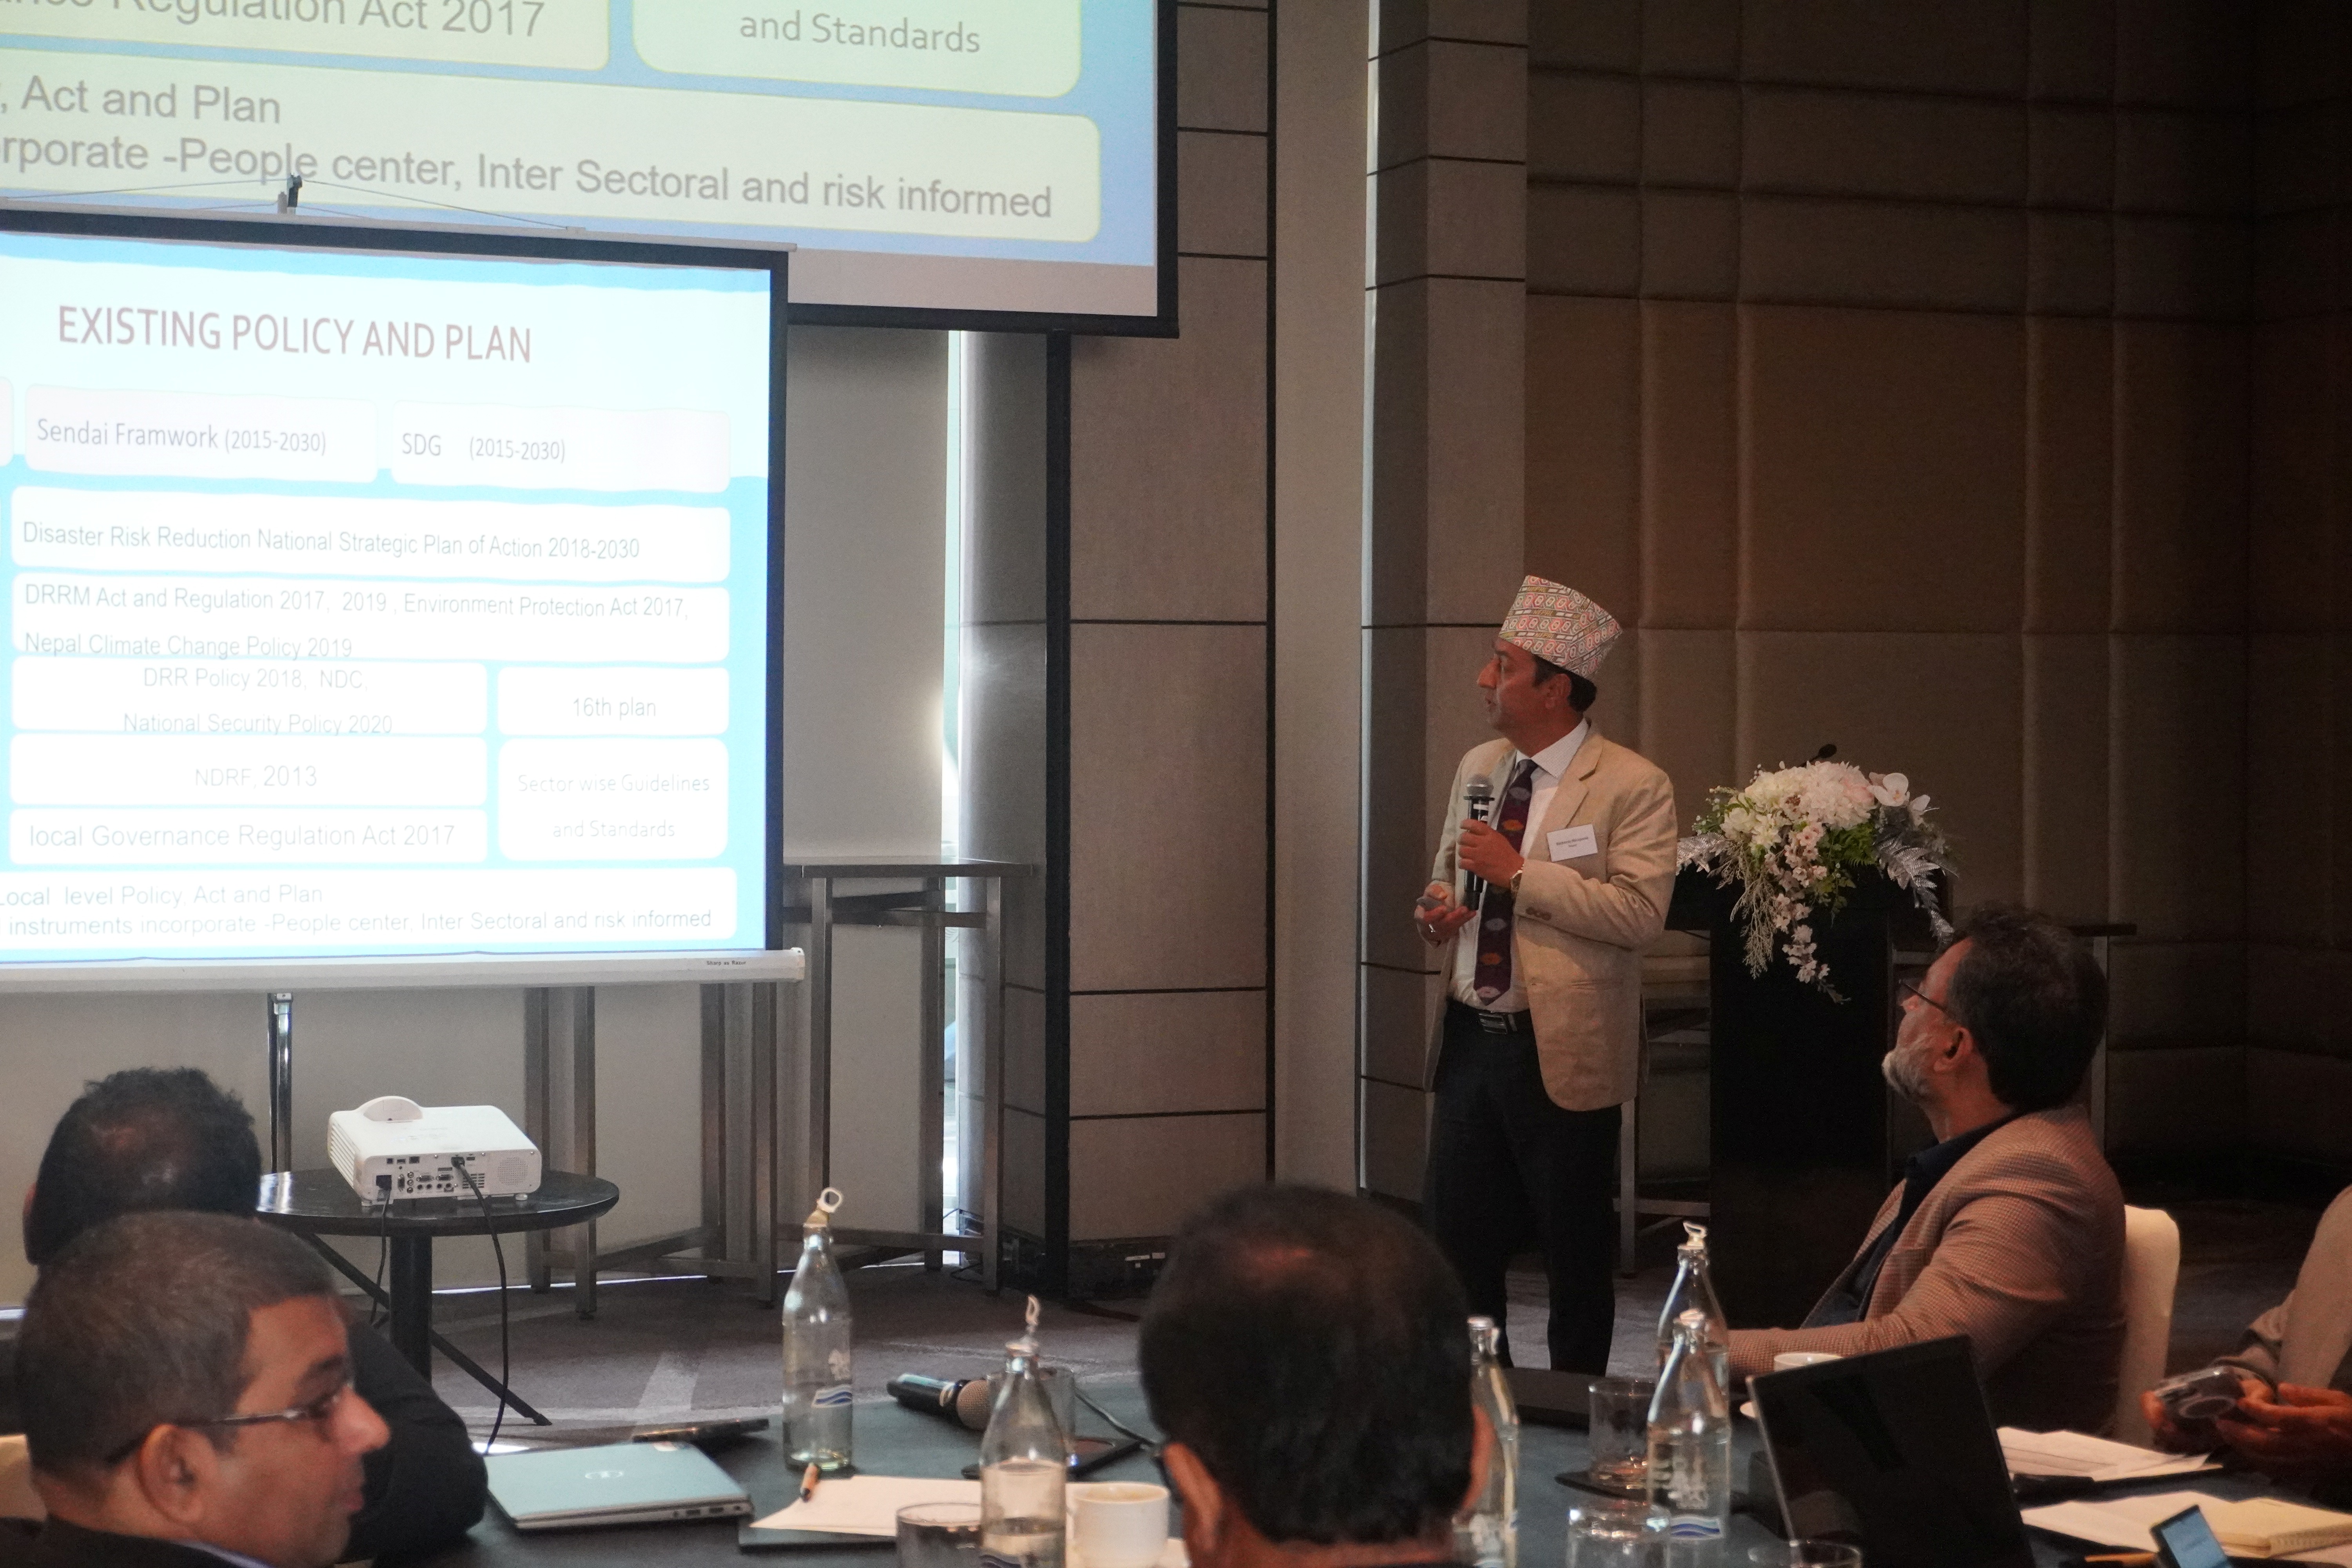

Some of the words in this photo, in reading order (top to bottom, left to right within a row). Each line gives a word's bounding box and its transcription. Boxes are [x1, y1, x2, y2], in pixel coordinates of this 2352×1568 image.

[358, 0, 428, 29] Act
[442, 0, 544, 36] 2017
[740, 9, 800, 41] and
[812, 13, 980, 53] Standards
[21, 75, 89, 113] Act
[102, 83, 176, 118] and
[194, 84, 280, 124] Plan
[479, 153, 563, 191] Inter
[576, 159, 728, 200] Sectoral
[742, 171, 808, 205] and
[824, 173, 885, 209] risk
[899, 177, 1051, 218] informed
[60, 305, 220, 349] EXISTING
[233, 314, 354, 354] POLICY
[363, 321, 434, 358] AND
[446, 324, 530, 363] PLAN
[37, 418, 107, 445] Sendai
[116, 423, 218, 448] Framwork
[225, 429, 326, 456] (2015-2030)
[402, 433, 441, 456] SDG
[470, 437, 565, 463] (2015-2030)
[23, 521, 104, 546] Disaster
[111, 526, 150, 546] Risk
[157, 526, 250, 549] Reduction
[258, 528, 332, 550] National
[339, 531, 417, 558] Strategic
[424, 534, 462, 554] Plan
[469, 534, 485, 554] of
[489, 535, 542, 557] Action
[548, 537, 639, 559] 2018-2030
[25, 583, 90, 605] DRRM
[96, 587, 126, 607] Act
[133, 588, 167, 607] and
[174, 587, 273, 613] Regulation
[404, 593, 513, 615] Environment
[520, 596, 604, 617] Protection
[610, 597, 637, 615] Act
[25, 632, 81, 658] Nepal
[89, 634, 160, 655] Climate
[167, 635, 239, 661] Change
[247, 635, 301, 661] Policy
[308, 637, 352, 658] 2019
[144, 667, 187, 686] DRR
[195, 668, 250, 691] Policy
[573, 697, 611, 717] 16th
[619, 697, 656, 720] plan
[123, 713, 200, 735] National
[207, 714, 281, 736] Security
[289, 714, 342, 737] Policy
[348, 715, 393, 737] 2020
[263, 765, 317, 787] 2013
[518, 774, 574, 792] Sector
[580, 775, 616, 791] wise
[622, 774, 710, 792] Guidelines
[30, 825, 82, 846] local
[92, 825, 229, 846] Governance
[239, 824, 355, 851] Regulation
[362, 825, 395, 845] Act
[404, 825, 455, 846] 2017
[553, 821, 584, 838] and
[590, 820, 675, 837] Standards
[0, 887, 50, 906] ocal
[65, 886, 113, 905] level
[193, 886, 225, 904] Act
[234, 886, 270, 903] and
[279, 884, 322, 902] Plan
[9, 917, 132, 935] instruments
[141, 916, 256, 936] incorporate
[422, 913, 463, 930] Inter
[471, 912, 546, 930] Sectoral
[554, 912, 587, 929] and
[595, 912, 625, 928] risk
[633, 910, 711, 927] informed
